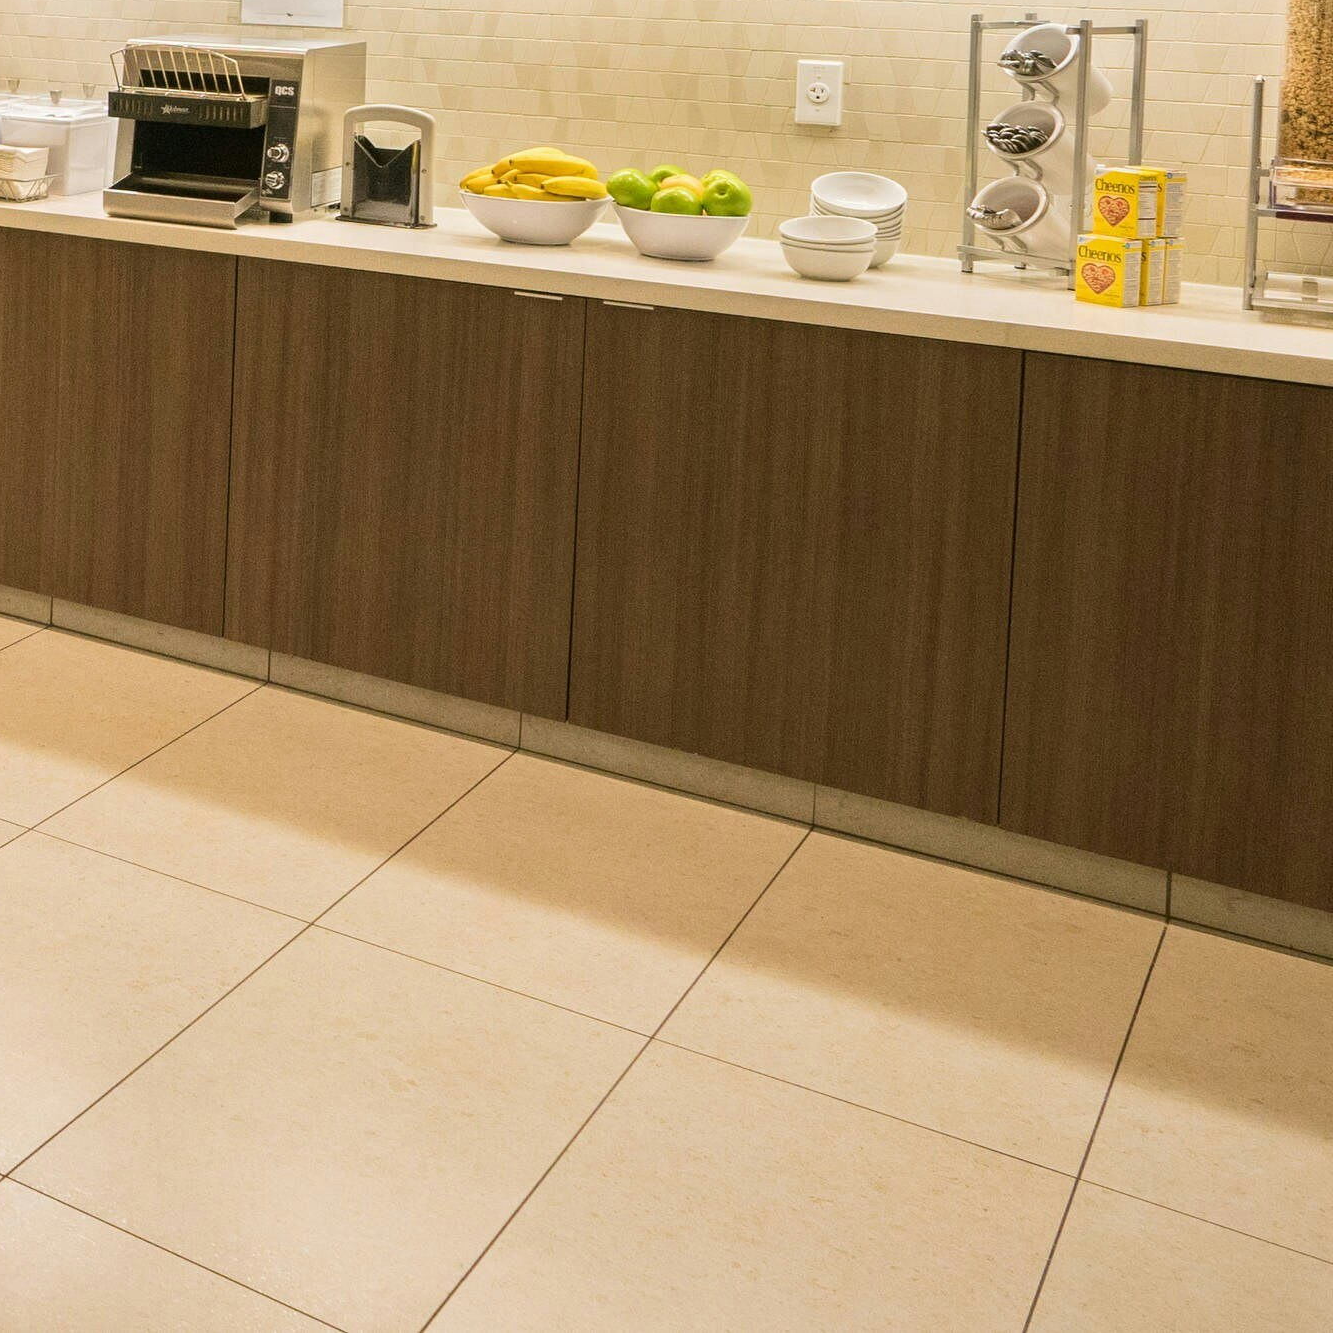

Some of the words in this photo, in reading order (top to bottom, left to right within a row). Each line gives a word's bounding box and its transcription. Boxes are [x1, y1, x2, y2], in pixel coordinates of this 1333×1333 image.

[274, 85, 295, 96] QCS
[1095, 178, 1135, 194] Cheerios
[1078, 245, 1122, 263] Cheerios
